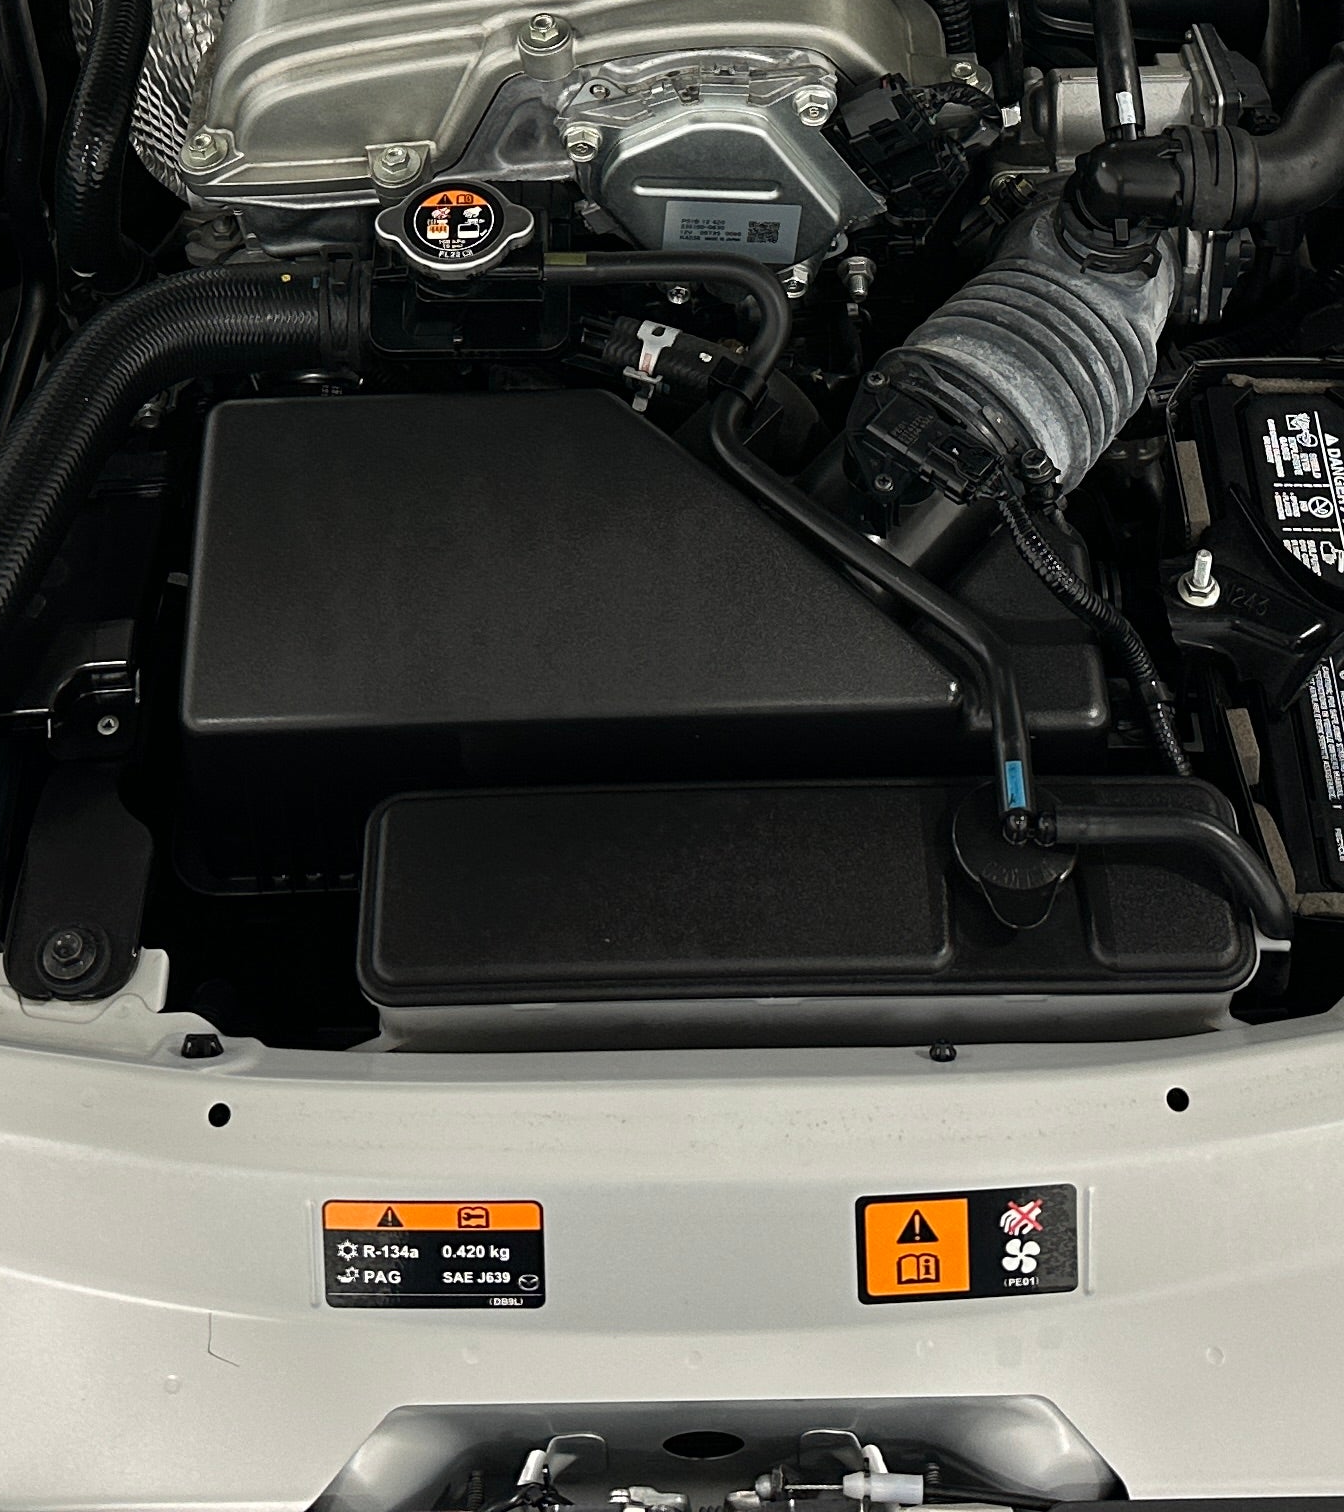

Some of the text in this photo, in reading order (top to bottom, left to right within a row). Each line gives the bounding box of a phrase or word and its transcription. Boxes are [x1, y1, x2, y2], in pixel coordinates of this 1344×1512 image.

[363, 1245, 510, 1261] R-134a 0.420 kg
[363, 1271, 511, 1283] PAG SAE J639
[1004, 1277, 1039, 1287] (PE01)
